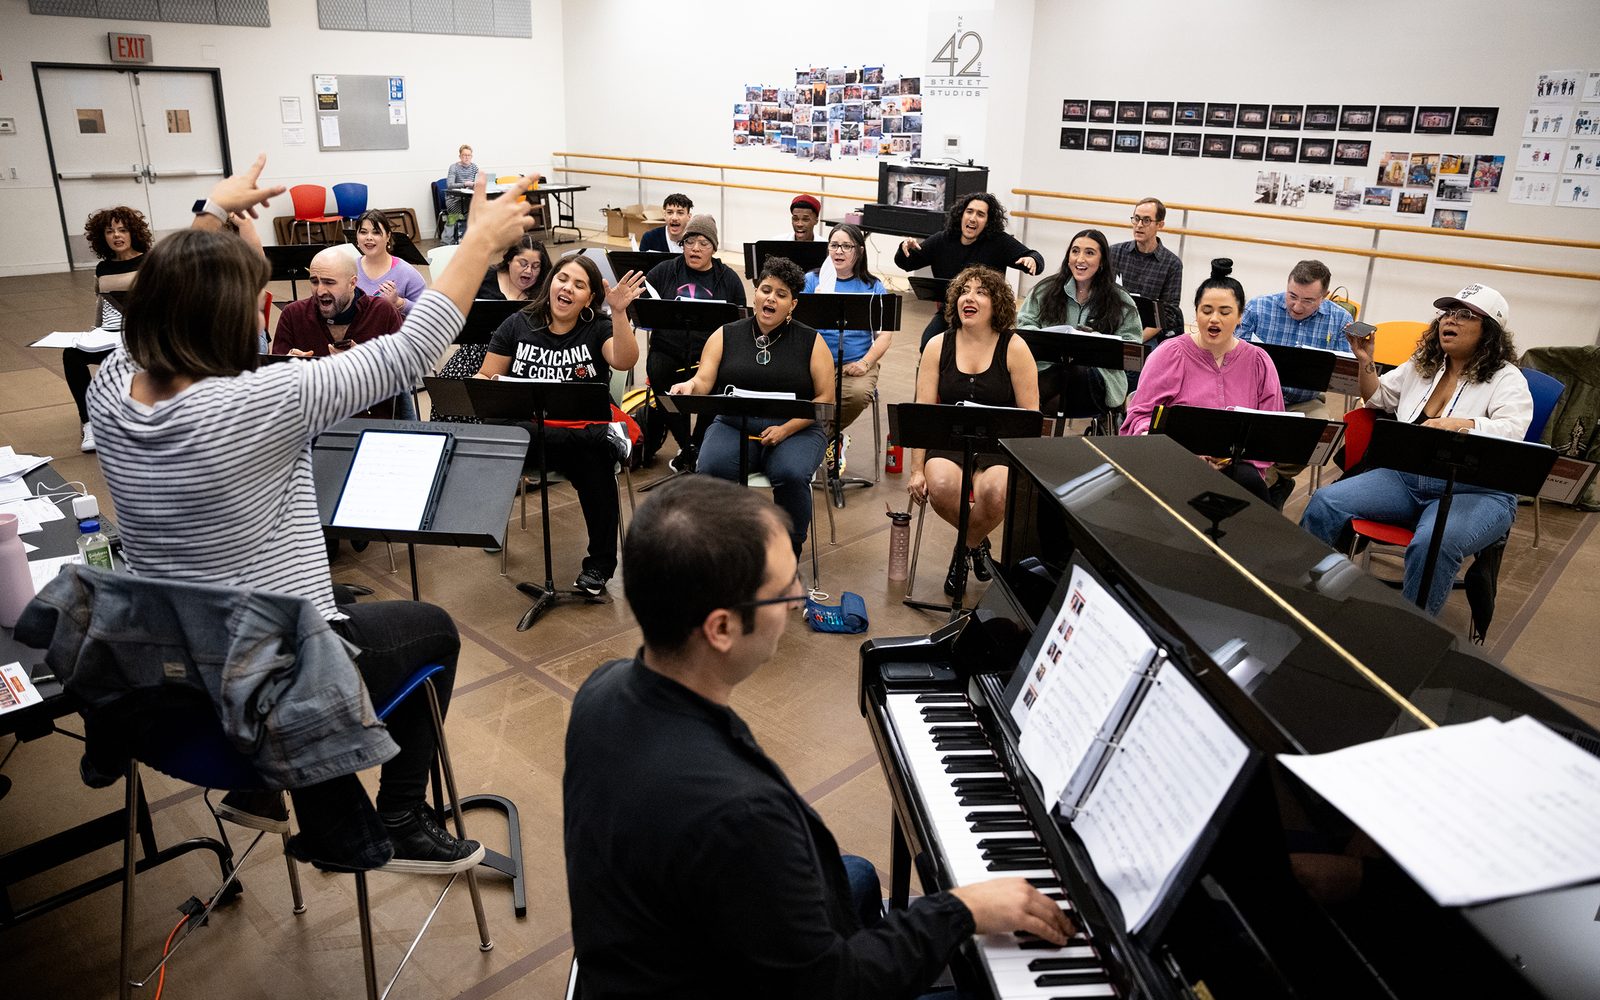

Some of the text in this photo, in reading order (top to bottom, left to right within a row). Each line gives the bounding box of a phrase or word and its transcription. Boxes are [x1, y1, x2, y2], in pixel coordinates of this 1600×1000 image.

[117, 36, 144, 58] EXIT
[931, 31, 983, 77] 42
[515, 342, 592, 366] MEXICANA
[511, 359, 526, 376] DE
